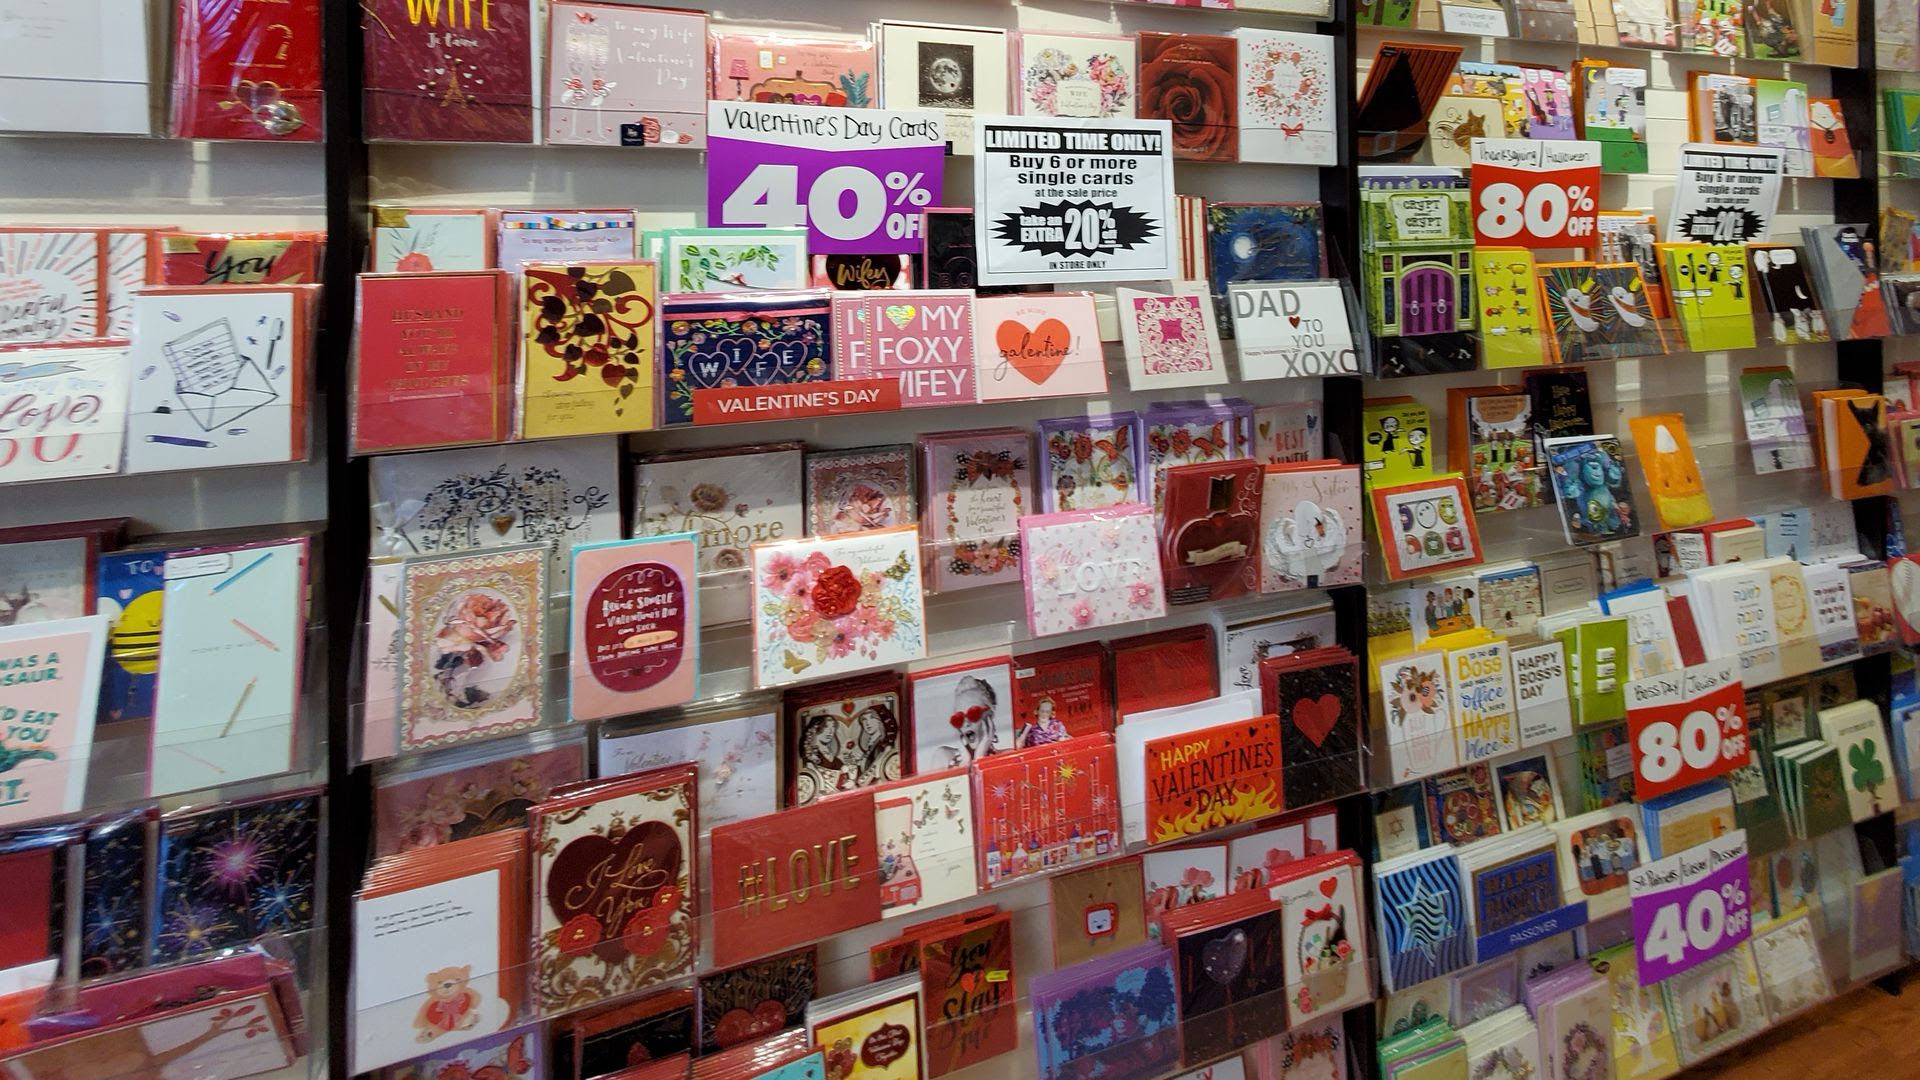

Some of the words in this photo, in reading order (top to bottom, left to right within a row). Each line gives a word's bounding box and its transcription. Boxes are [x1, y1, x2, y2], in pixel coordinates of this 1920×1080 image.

[724, 108, 838, 133] Valentine's
[844, 115, 882, 144] Day
[889, 117, 940, 141] Cards
[986, 130, 1062, 150] LIMITED
[1063, 132, 1109, 151] TIME
[1111, 134, 1162, 151] ONLY!
[1010, 155, 1044, 169] Buy
[1050, 155, 1061, 169] 6
[1067, 158, 1085, 169] or
[1090, 158, 1137, 169] more
[1018, 171, 1076, 186] single
[1082, 172, 1134, 185] cards
[1696, 172, 1713, 183] Buy
[1716, 172, 1723, 182] 6
[1737, 175, 1763, 184] more
[1035, 189, 1046, 198] at
[1048, 188, 1064, 198] the
[1066, 188, 1089, 198] sale
[1091, 188, 1118, 199] price
[1697, 185, 1730, 195] single
[1732, 185, 1760, 195] cards
[722, 164, 932, 240] 40%
[1476, 183, 1594, 239] 80%
[1567, 217, 1594, 238] OFF
[1020, 215, 1046, 226] take
[1047, 216, 1063, 226] an
[1021, 227, 1064, 243] EXTRA
[1059, 261, 1084, 269] STORE
[1086, 261, 1106, 269] ONLY
[1234, 289, 1301, 319] DAD
[876, 306, 883, 332] I
[921, 305, 965, 331] MY
[1302, 318, 1323, 333] TO
[878, 335, 963, 365] FOXY
[1292, 333, 1324, 348] YOU
[992, 332, 1082, 382] galentine!
[1281, 349, 1361, 378] XOXO
[717, 391, 839, 414] VALENTINE'S
[844, 388, 881, 405] DAY
[1275, 428, 1306, 451] BEST
[1517, 651, 1558, 672] HAPPY
[1518, 665, 1563, 686] BOSS'S
[1461, 684, 1504, 711] office
[1520, 683, 1544, 700] DAY
[1659, 679, 1680, 696] Day
[21, 709, 59, 725] EAT
[6, 725, 51, 743] YOU
[1638, 703, 1743, 783] 80%
[1160, 738, 1211, 771] HAPPY
[1196, 778, 1238, 815] DAY
[739, 834, 861, 919] #LOVE
[1509, 919, 1558, 944] PASSOVER
[1643, 878, 1747, 964] 40%
